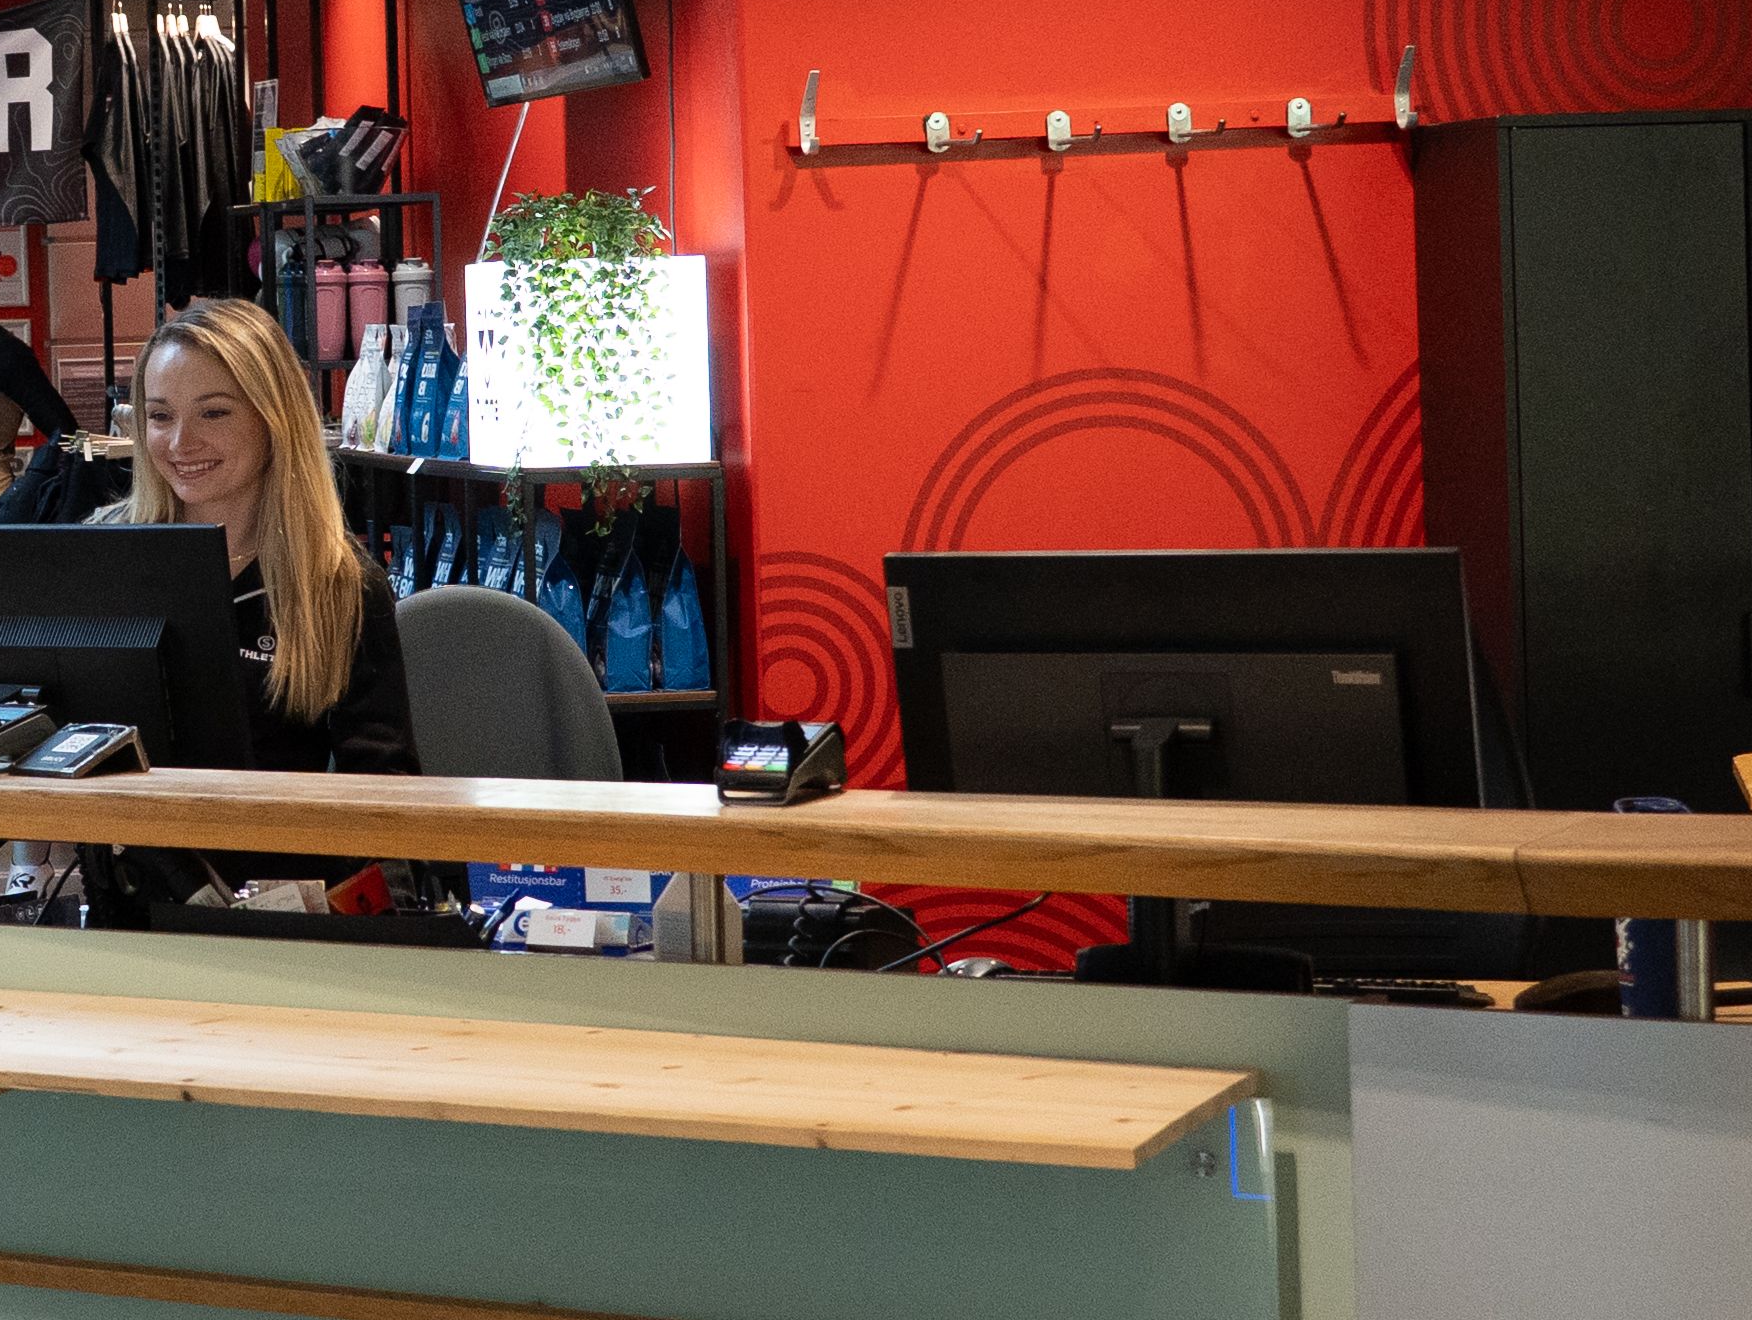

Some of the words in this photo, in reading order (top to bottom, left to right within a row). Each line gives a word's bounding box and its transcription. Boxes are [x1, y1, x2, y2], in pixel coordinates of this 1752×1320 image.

[894, 592, 908, 642] Lenovo
[489, 872, 567, 888] Restitusjonsbar
[610, 885, 627, 895] 35,-
